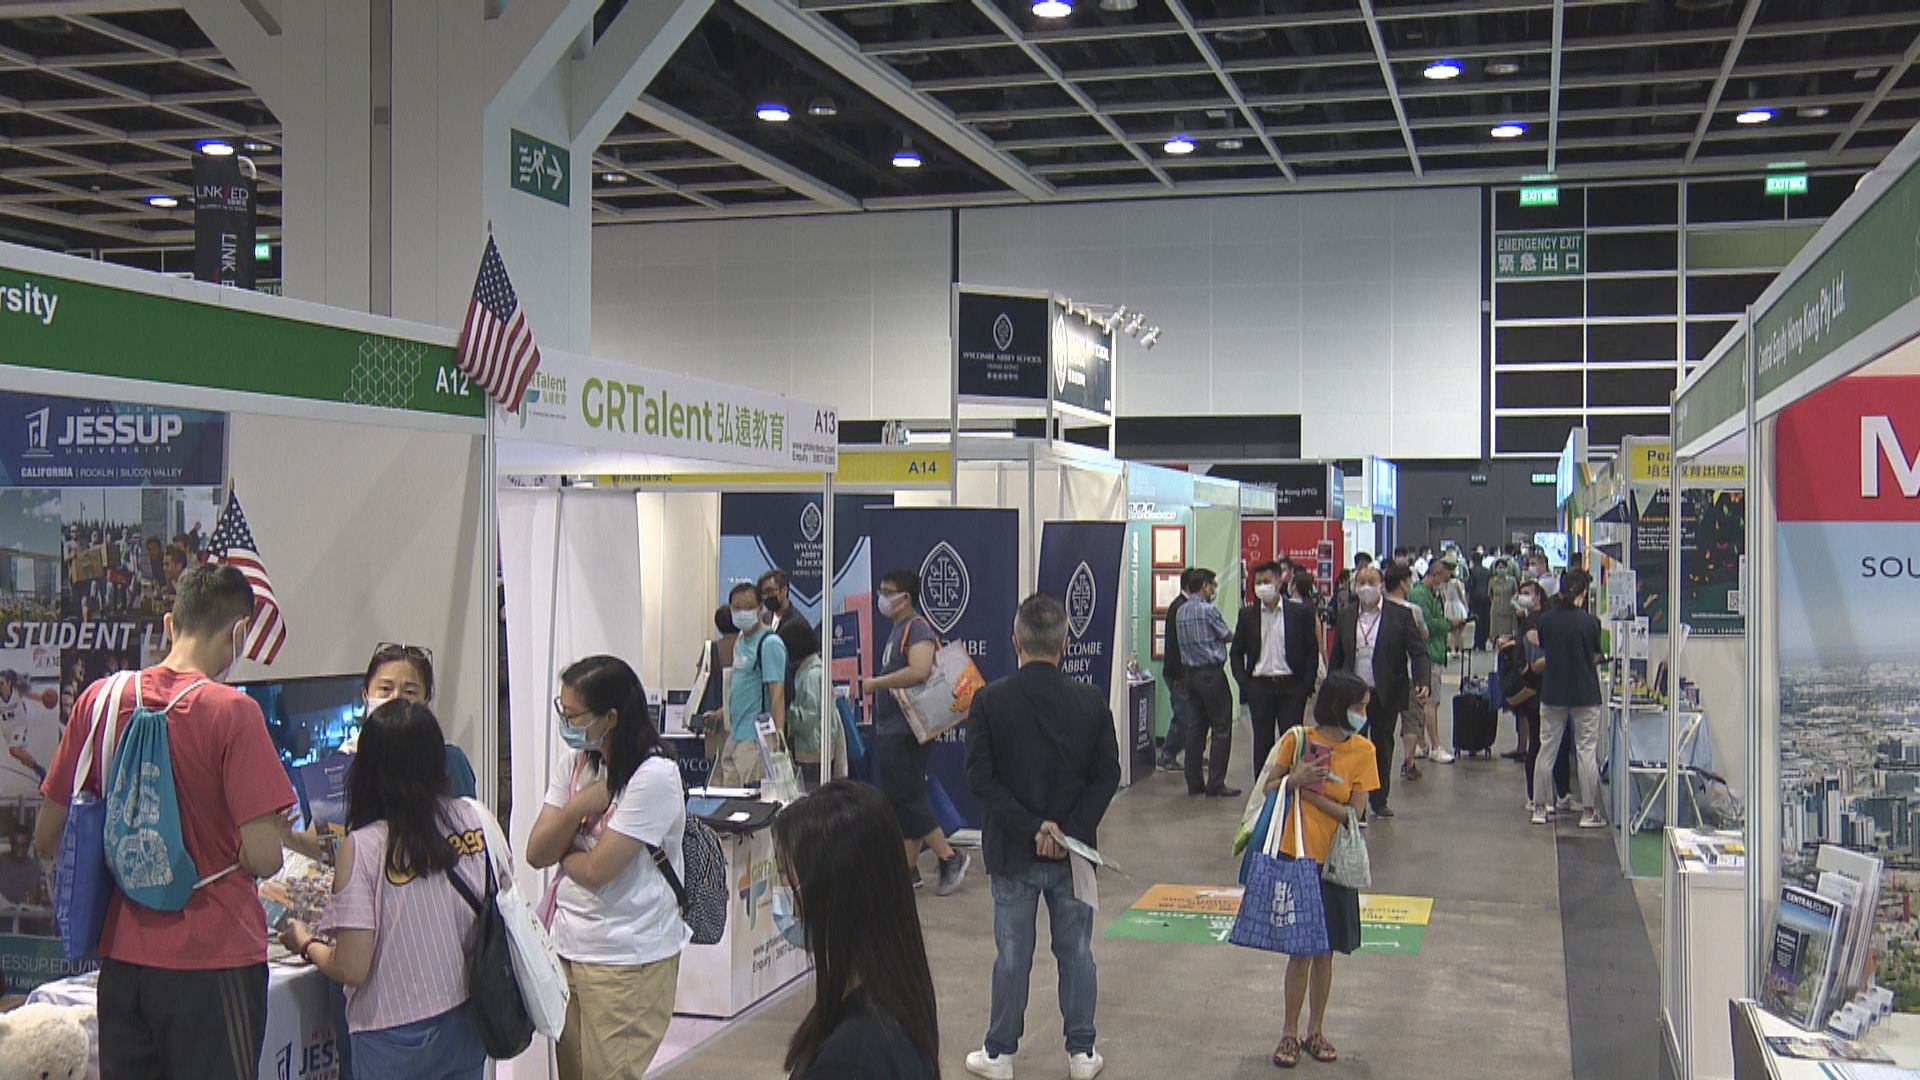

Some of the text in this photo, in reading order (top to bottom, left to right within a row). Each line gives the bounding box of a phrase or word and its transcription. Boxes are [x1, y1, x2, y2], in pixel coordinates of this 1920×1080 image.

[221, 233, 237, 271] LINK
[1498, 235, 1581, 251] EMERGENCY EXIT
[1499, 252, 1579, 272] 緊急出口
[1787, 316, 1803, 355] Hong
[1803, 302, 1819, 343] Kong
[1820, 287, 1831, 335] Pty
[436, 365, 469, 396] A12
[527, 371, 567, 391] RTalent
[581, 377, 713, 443] GRTalent
[814, 409, 836, 435] A13
[58, 414, 183, 446] JESSUP
[717, 401, 785, 452] 弘遠教育
[21, 466, 183, 478] CALIFORNIA ROCKLIN SILICON VALLEY
[908, 461, 937, 475] A14
[1861, 556, 1920, 578] SOU
[4, 621, 136, 650] STUDENT
[1064, 641, 1102, 656] COMBE
[1061, 658, 1091, 673] ABBEY
